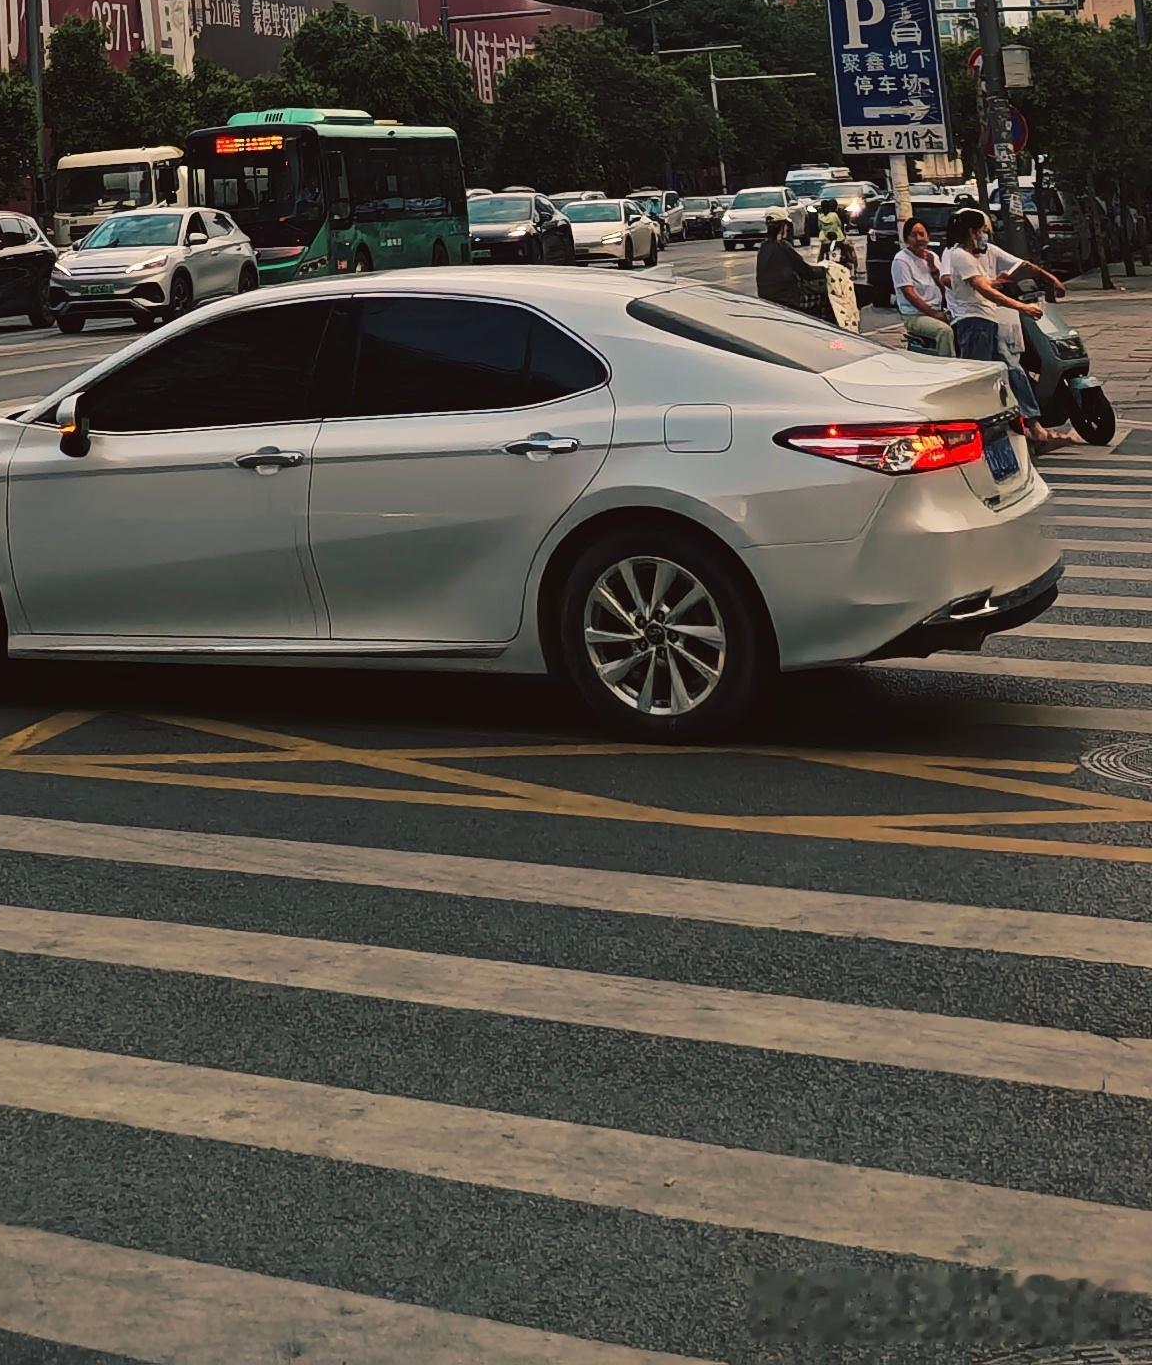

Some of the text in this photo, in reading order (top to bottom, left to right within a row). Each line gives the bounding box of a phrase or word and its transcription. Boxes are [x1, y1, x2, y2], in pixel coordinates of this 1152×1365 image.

[841, 49, 932, 73] 聚鑫地下
[854, 73, 924, 96] 停车场
